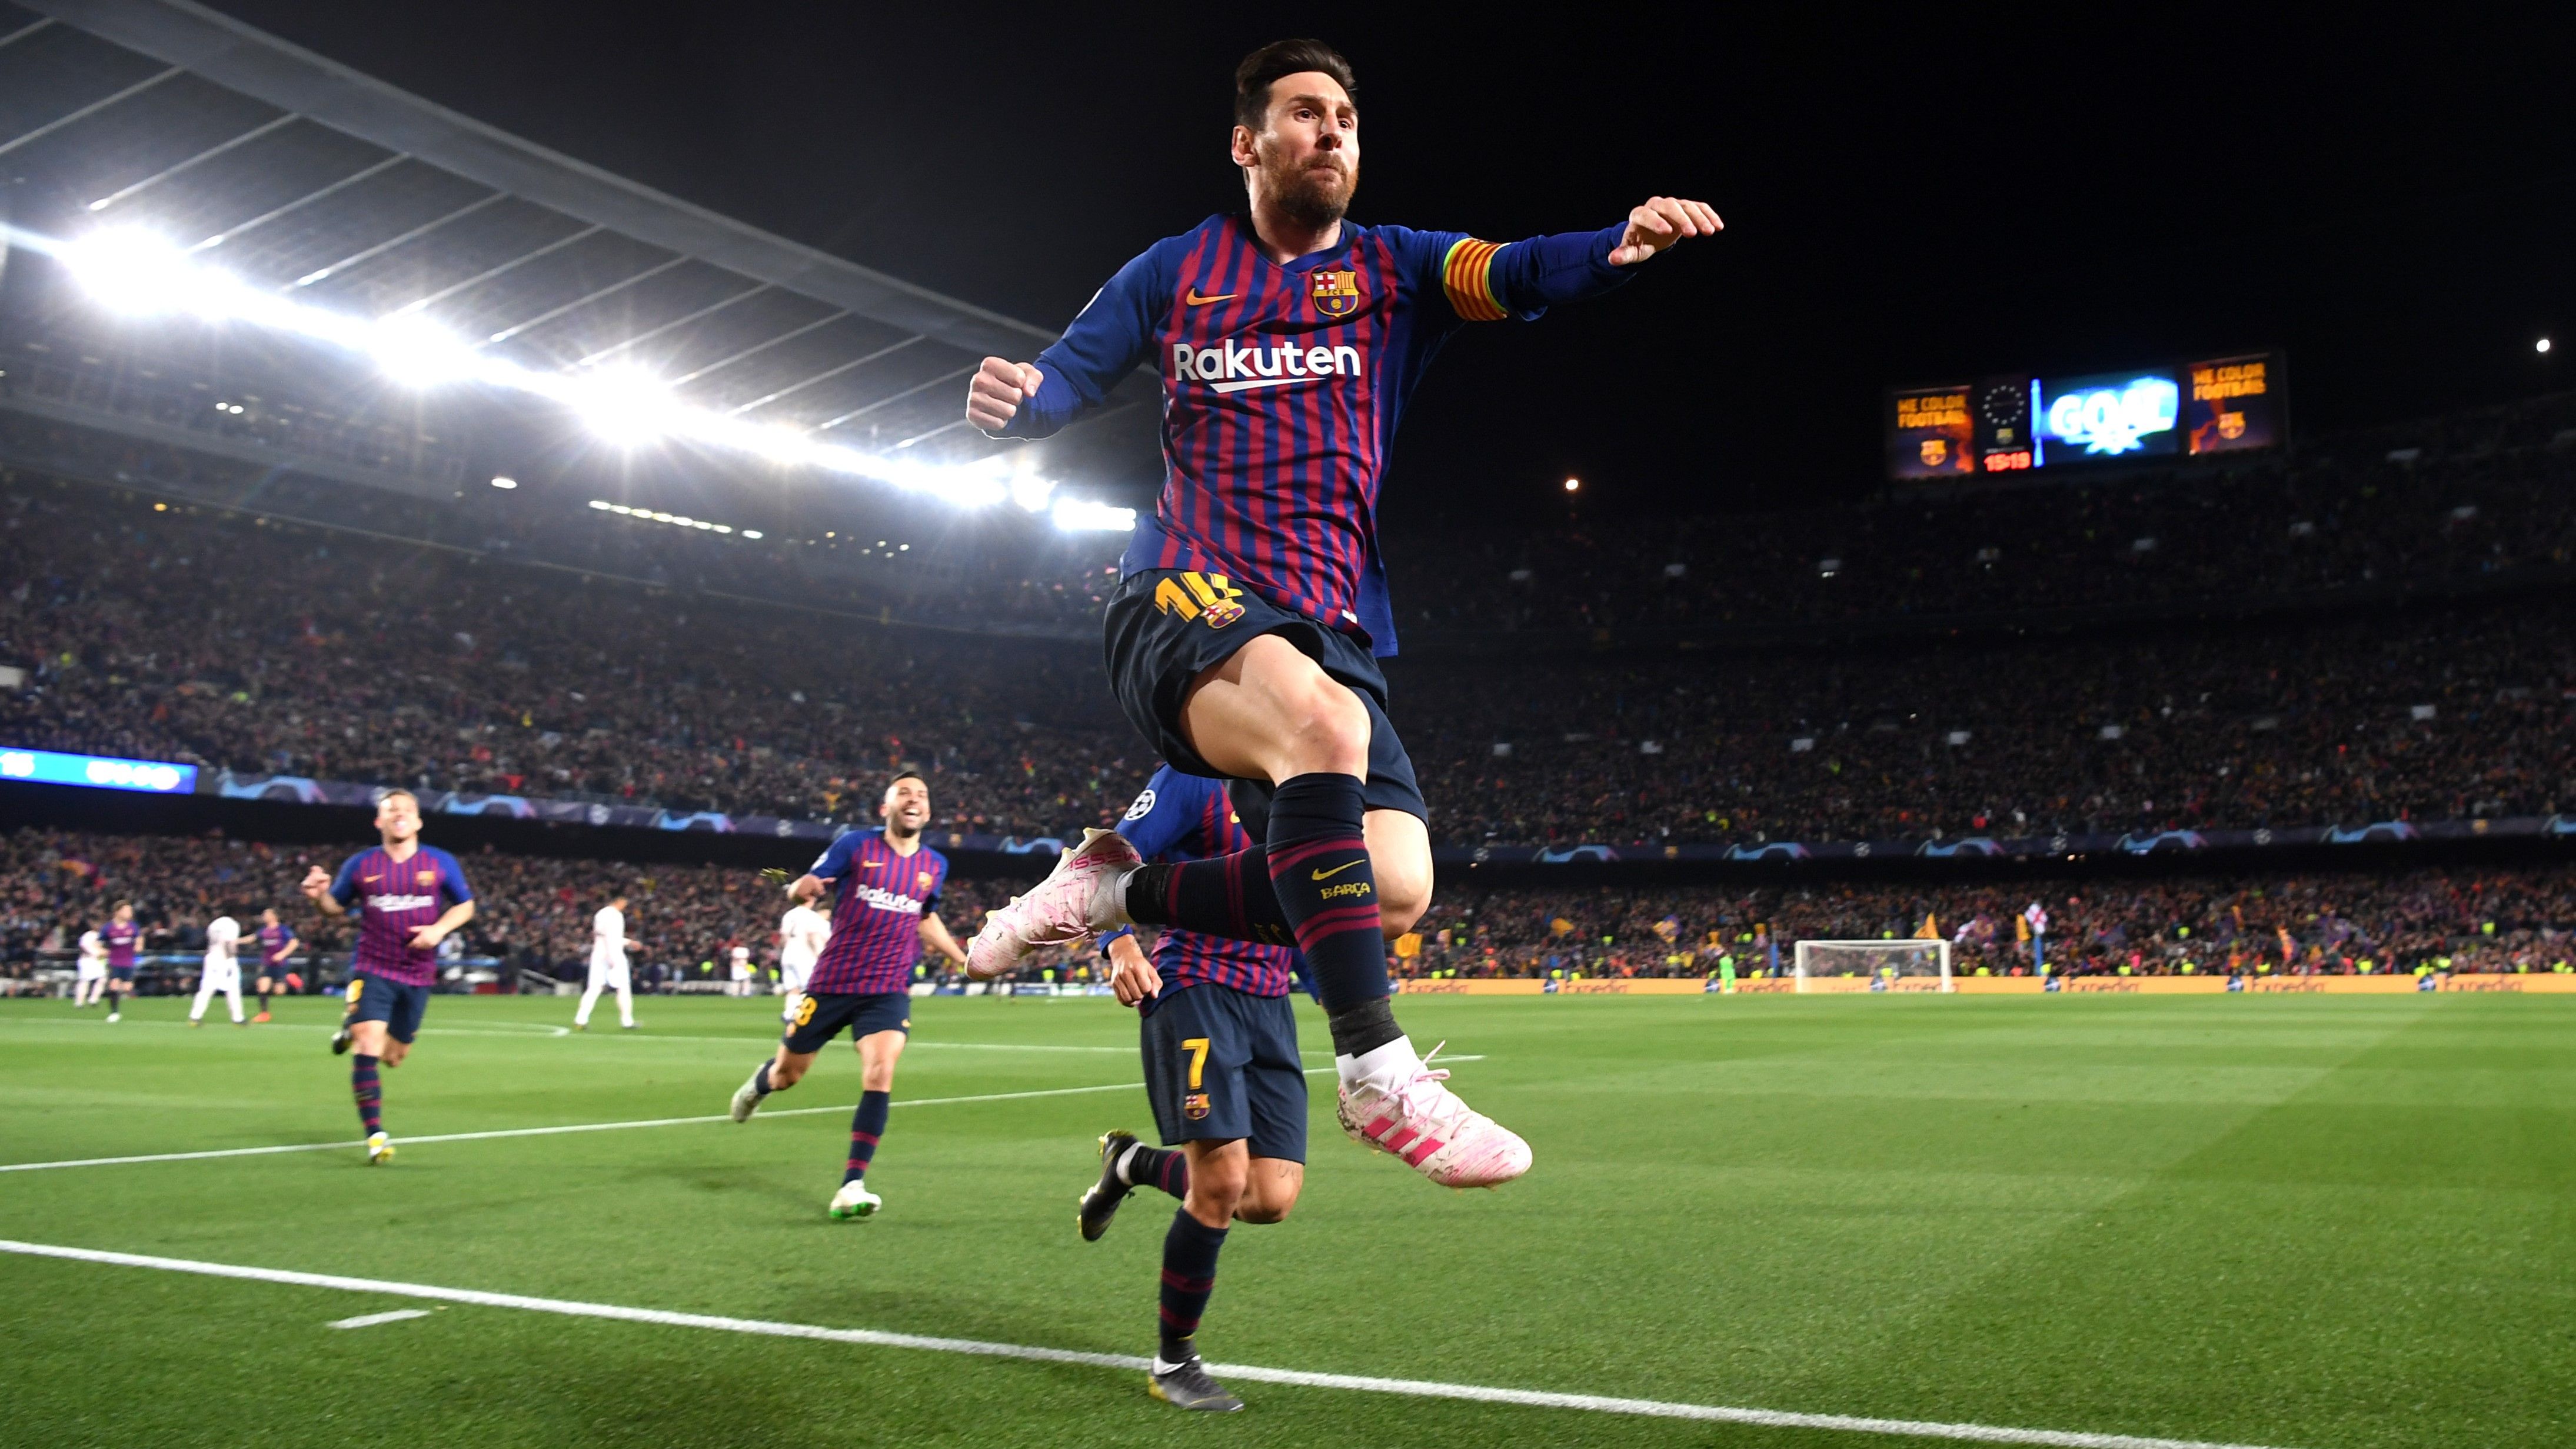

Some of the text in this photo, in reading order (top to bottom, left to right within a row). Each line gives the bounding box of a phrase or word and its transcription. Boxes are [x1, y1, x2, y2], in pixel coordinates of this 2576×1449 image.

[1173, 339, 1361, 381] Rakuten
[1320, 882, 1370, 900] BARÇA
[1182, 1038, 1210, 1090] 7
